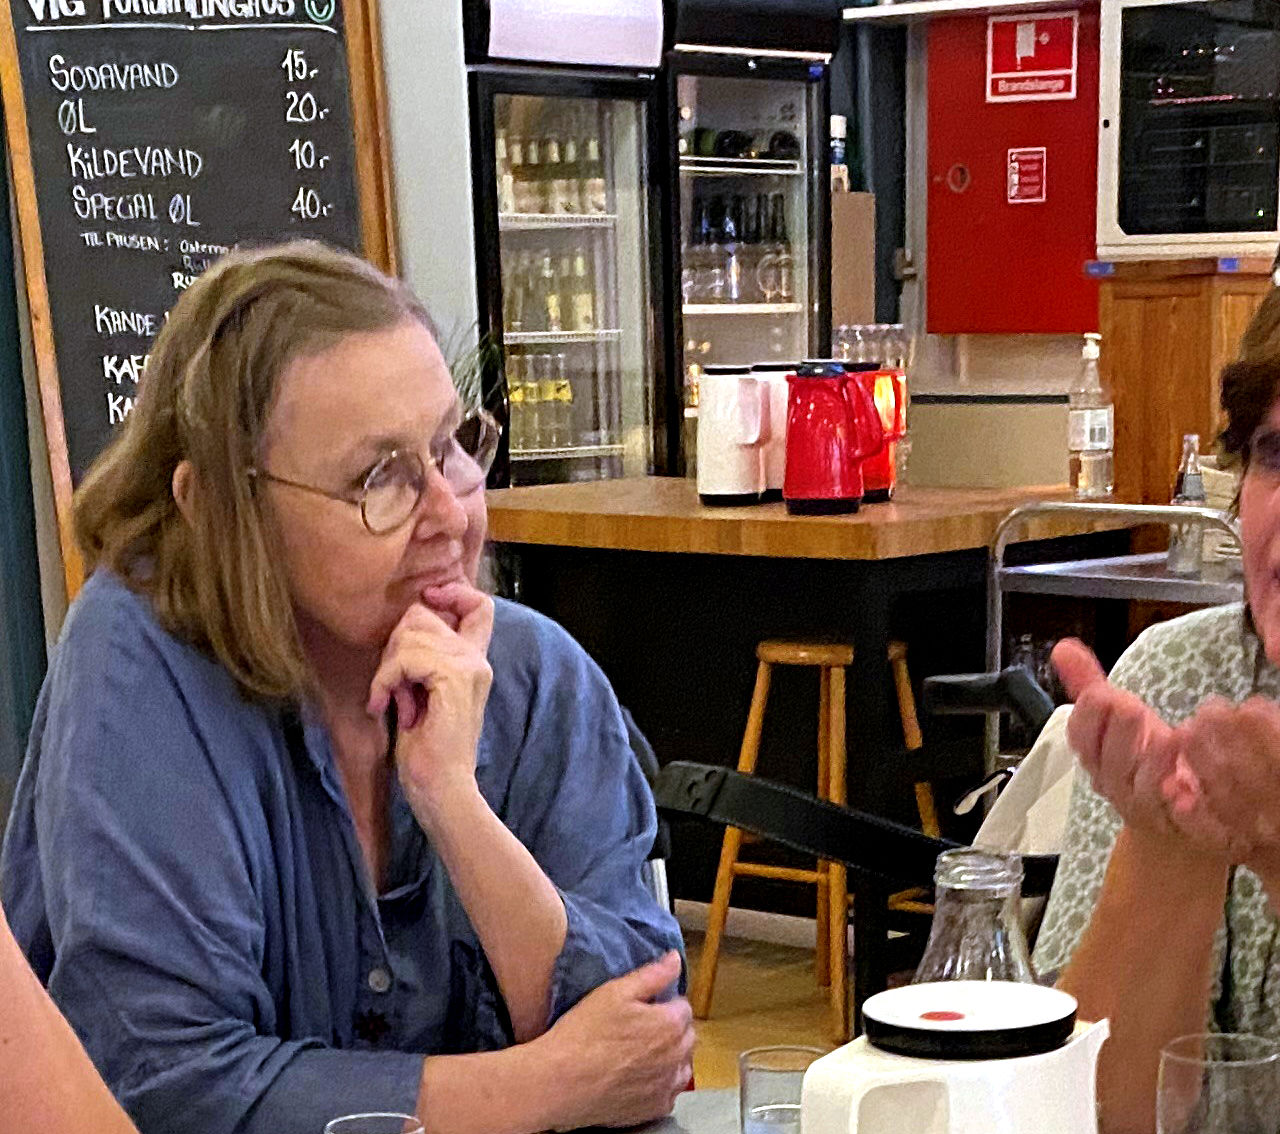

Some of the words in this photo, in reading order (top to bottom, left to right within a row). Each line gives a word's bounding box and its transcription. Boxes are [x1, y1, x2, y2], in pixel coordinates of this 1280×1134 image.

[49, 54, 179, 91] SODAVAND
[58, 98, 97, 135] ØL
[169, 193, 200, 227] ØL
[94, 304, 156, 337] KANDE
